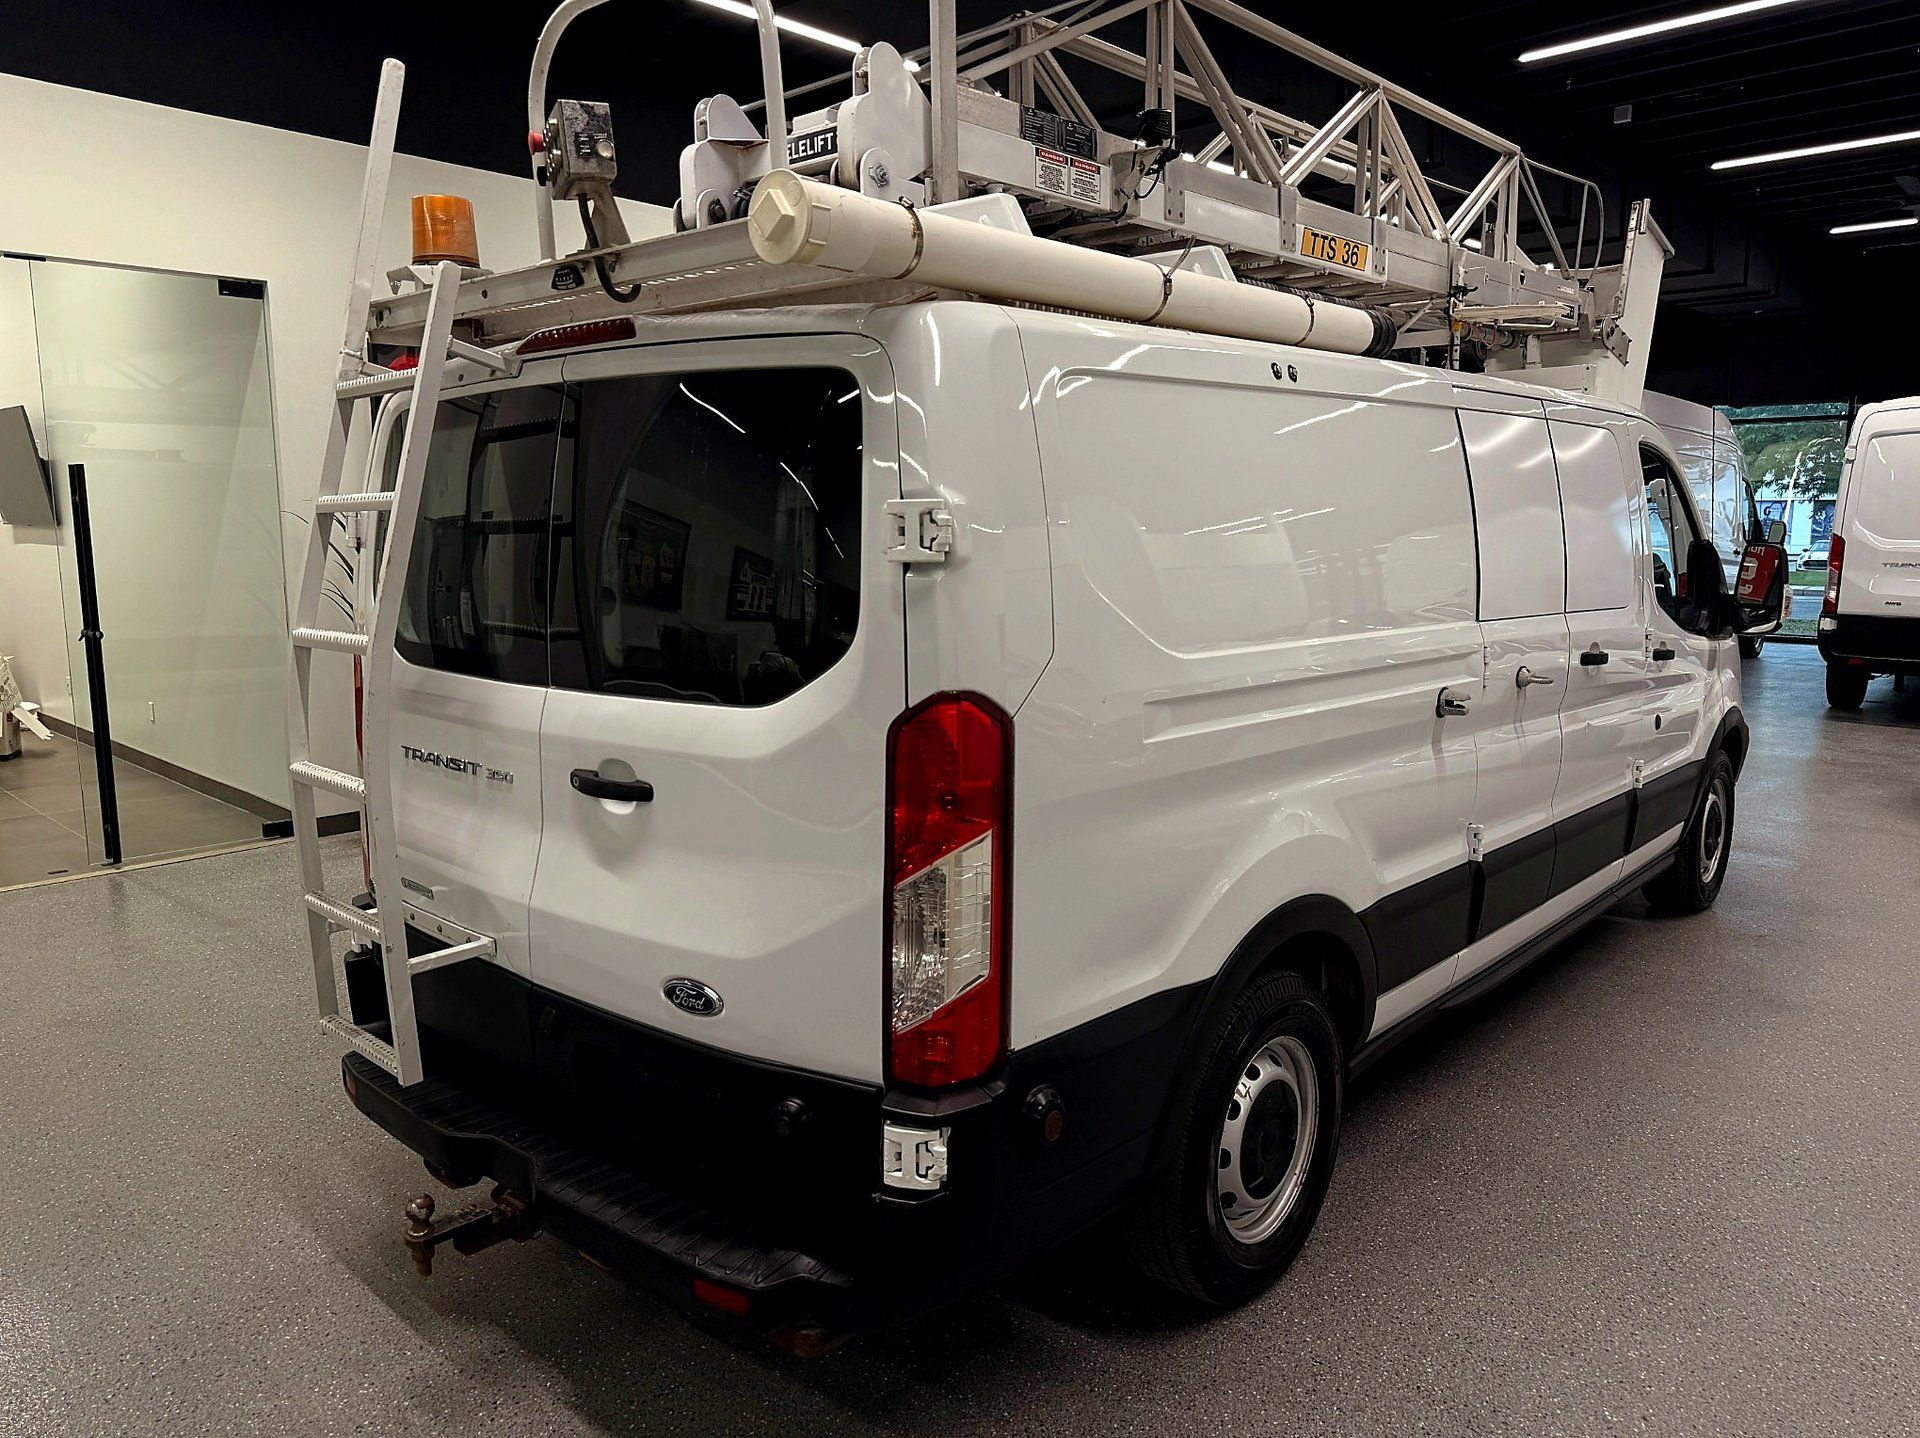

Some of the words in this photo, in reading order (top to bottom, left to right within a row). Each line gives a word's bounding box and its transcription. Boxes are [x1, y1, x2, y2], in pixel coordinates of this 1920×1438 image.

[786, 132, 834, 160] ELELIFT
[1040, 151, 1065, 162] DANGER
[1074, 161, 1097, 172] DANGER
[1311, 231, 1337, 261] TTS
[1341, 241, 1360, 267] 36
[400, 745, 483, 776] TRANSIT
[485, 767, 514, 785] 350
[672, 986, 705, 1010] Ford
